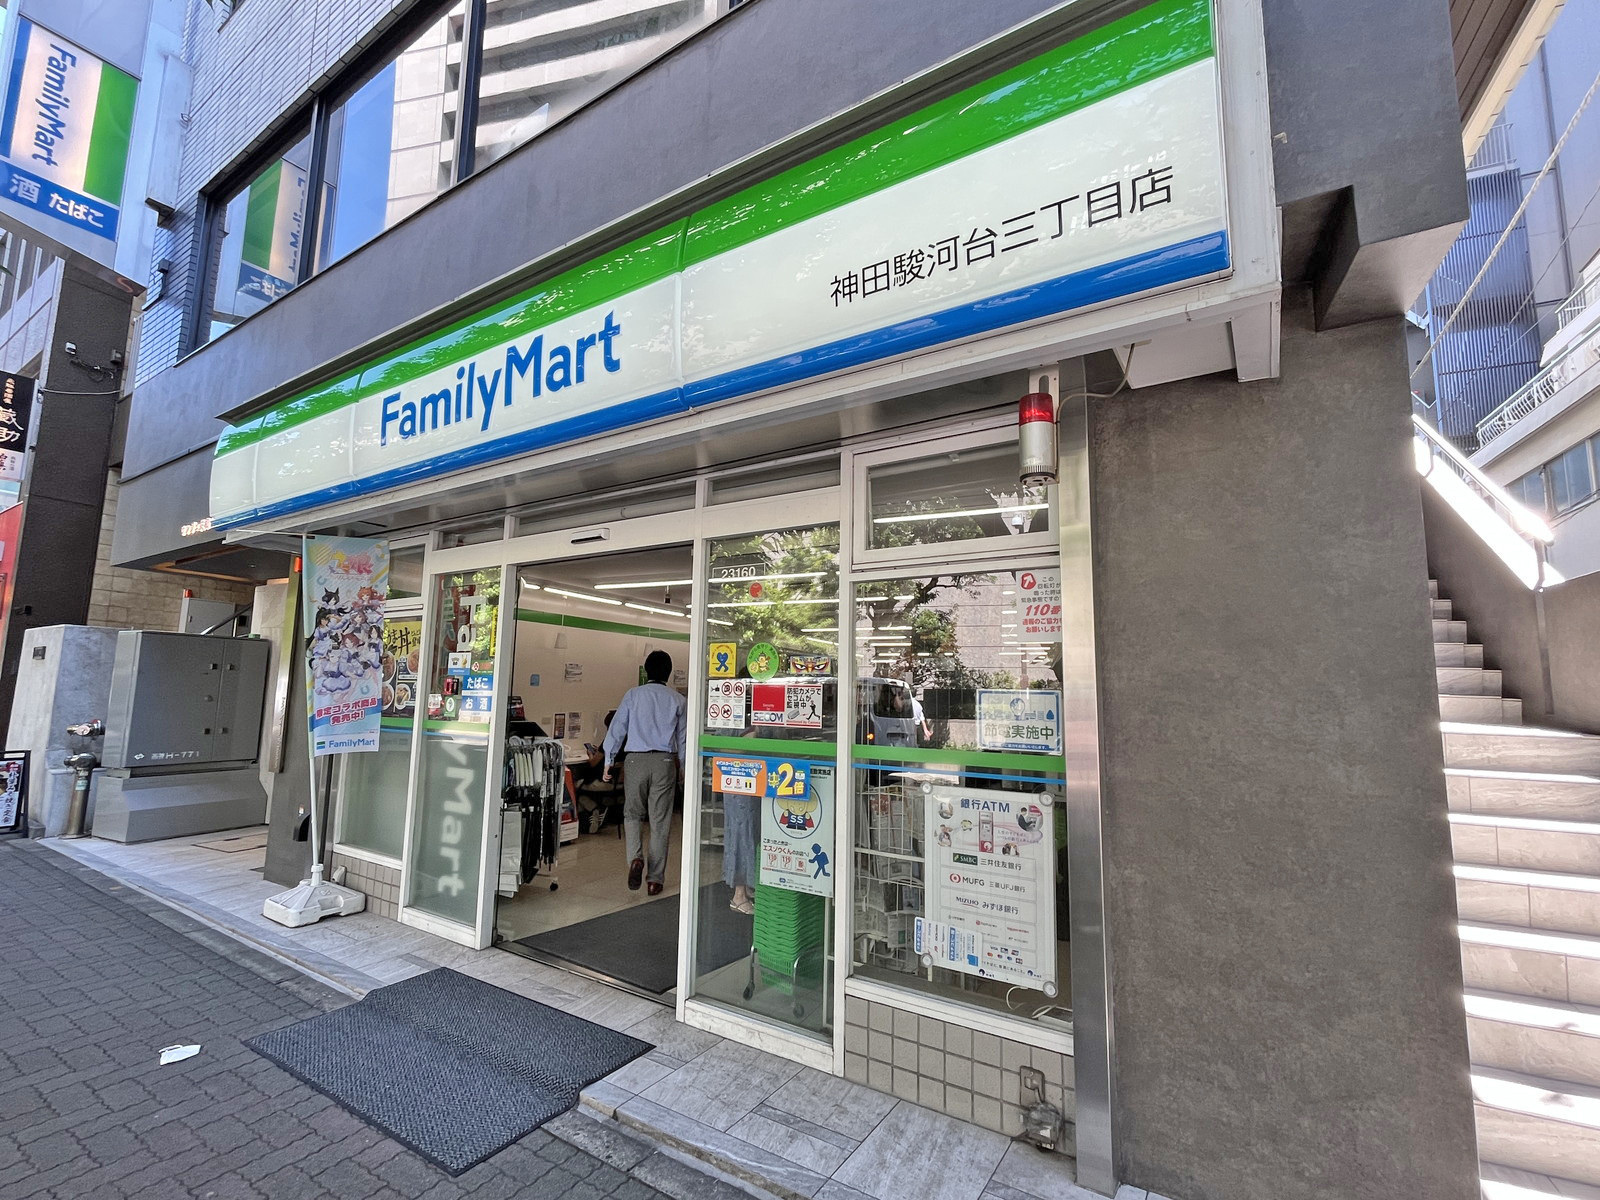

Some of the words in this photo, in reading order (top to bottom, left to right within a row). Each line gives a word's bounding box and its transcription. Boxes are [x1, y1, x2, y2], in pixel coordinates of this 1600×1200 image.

[32, 44, 77, 166] FamilyMart
[10, 173, 42, 204] 酒
[49, 192, 105, 229] たばこ
[829, 164, 1175, 308] 神田駿河台三丁目店
[380, 310, 622, 447] FamilyMart
[721, 566, 756, 579] 23160
[467, 676, 489, 689] たばこ
[787, 687, 822, 696] 防犯カメラで
[786, 701, 807, 709] 監視中
[331, 710, 365, 725] 発売中!
[753, 712, 784, 723] SECOM
[328, 738, 376, 748] FamilyMart
[960, 797, 1010, 814] 銀行ATM
[789, 814, 804, 824] SS
[960, 854, 977, 864] SMBC
[980, 857, 1022, 871] 三井住友銀行
[962, 876, 985, 886] MUFG
[989, 881, 1026, 893] 三菱UFJ銀行
[955, 896, 980, 906] MIZUHO
[981, 901, 1019, 915] みずほ銀行
